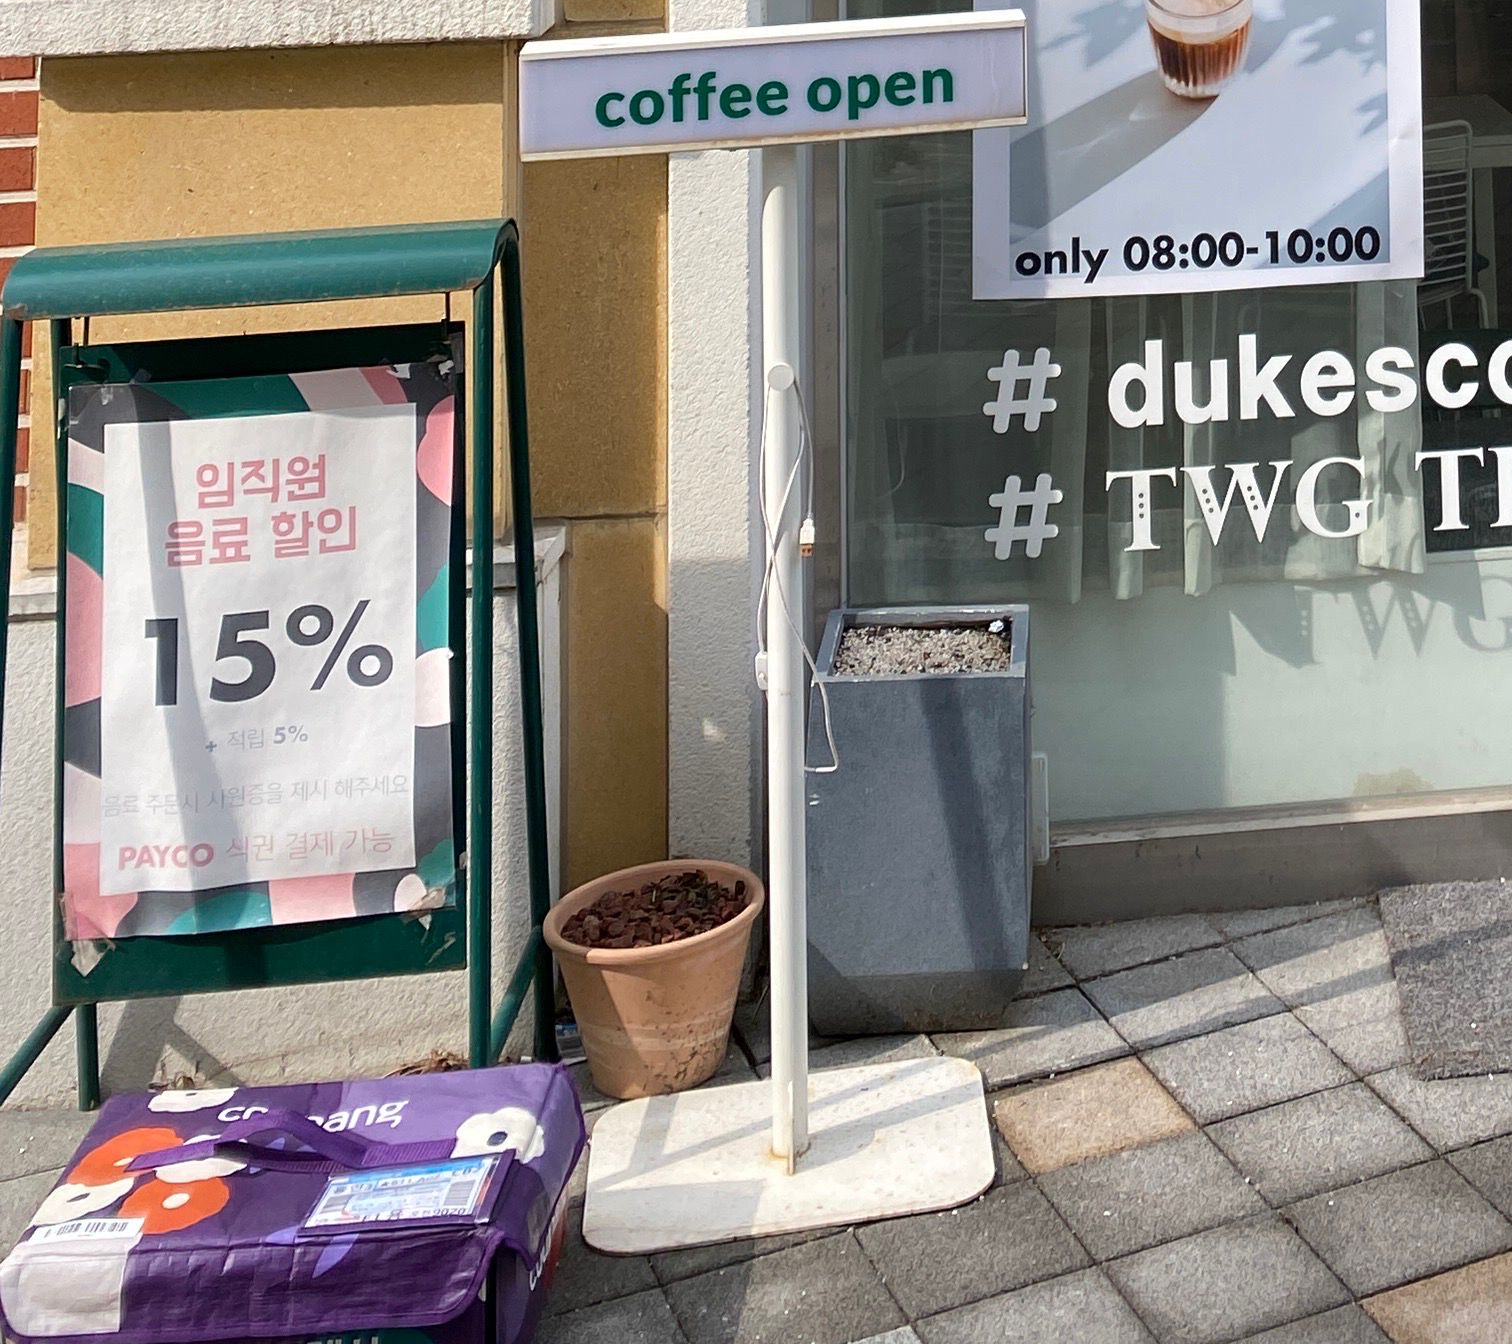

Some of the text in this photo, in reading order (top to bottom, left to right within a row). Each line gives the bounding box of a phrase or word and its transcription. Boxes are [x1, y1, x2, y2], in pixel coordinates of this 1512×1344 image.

[594, 66, 954, 128] coffee open
[1014, 225, 1382, 284] only 08:00-10:00
[195, 453, 326, 509] 임직원
[1105, 453, 1374, 553] TWG
[164, 505, 357, 567] 음료 할인
[143, 598, 394, 707] 15%
[226, 727, 265, 751] 적립
[272, 724, 309, 745] 5%
[207, 781, 284, 810] 사원증을
[290, 780, 328, 802] 제시
[334, 774, 409, 799] 해주세요
[118, 827, 395, 870] PAYCO 식권 결제 가능
